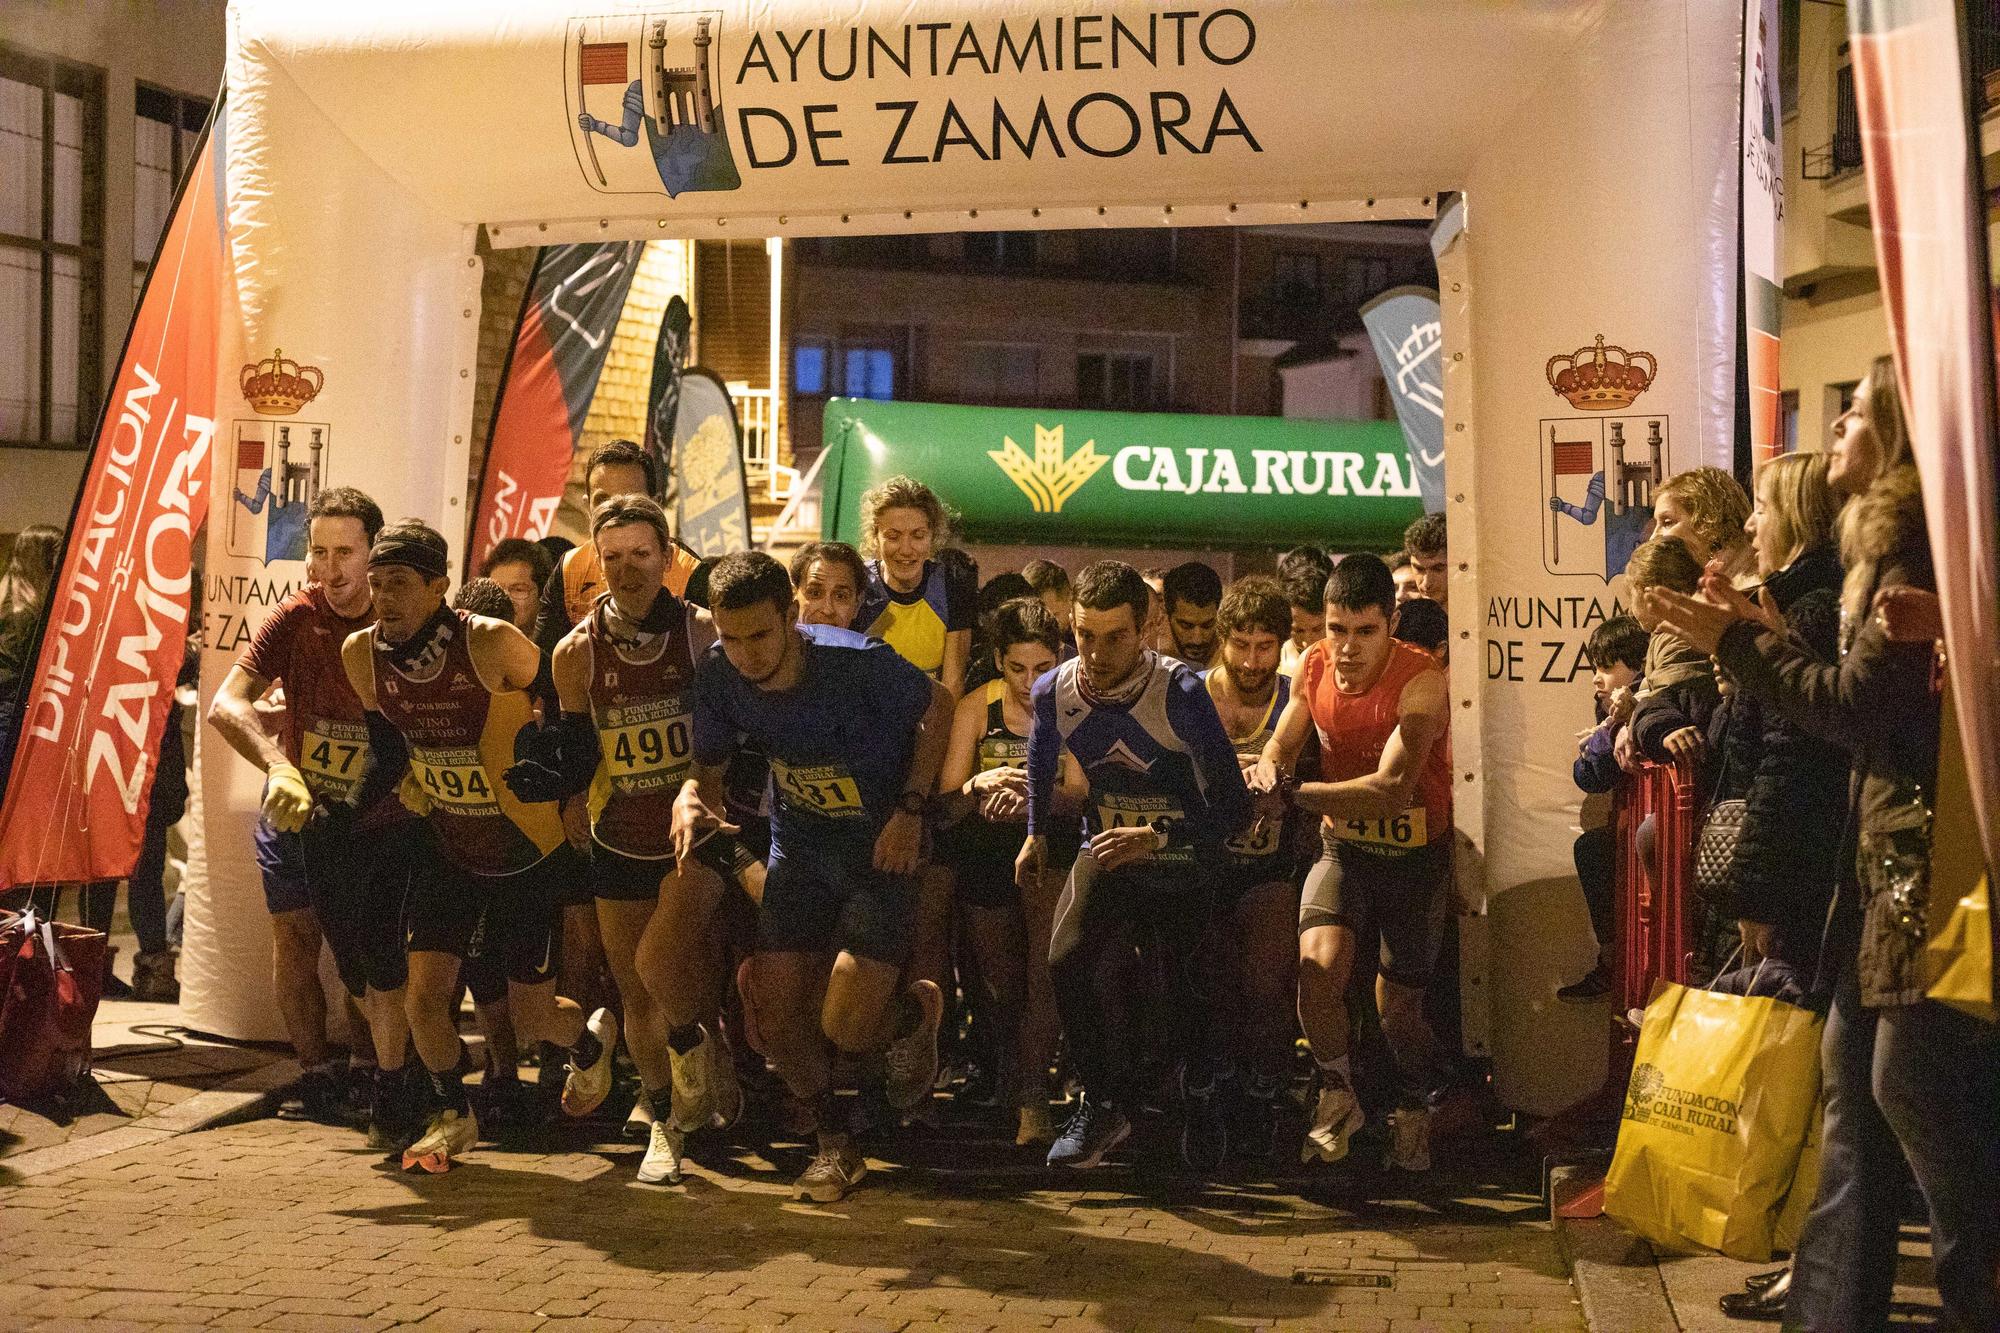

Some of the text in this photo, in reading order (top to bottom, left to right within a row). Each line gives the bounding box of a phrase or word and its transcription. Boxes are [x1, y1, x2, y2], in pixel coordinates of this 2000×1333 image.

[736, 8, 1257, 84] AYUNTAMIENTO
[738, 87, 1264, 168] DE ZAMORA
[1113, 445, 1247, 495] CAJA
[1487, 640, 1524, 682] DE
[417, 717, 450, 728] VINO
[430, 727, 468, 738] TORO
[615, 722, 689, 767] 490
[425, 767, 489, 798] 494
[637, 776, 665, 788] CAJA
[444, 805, 501, 816] CAJA RURAL
[1347, 814, 1412, 843] 416
[1653, 1101, 1738, 1135] CAJA RURAL
